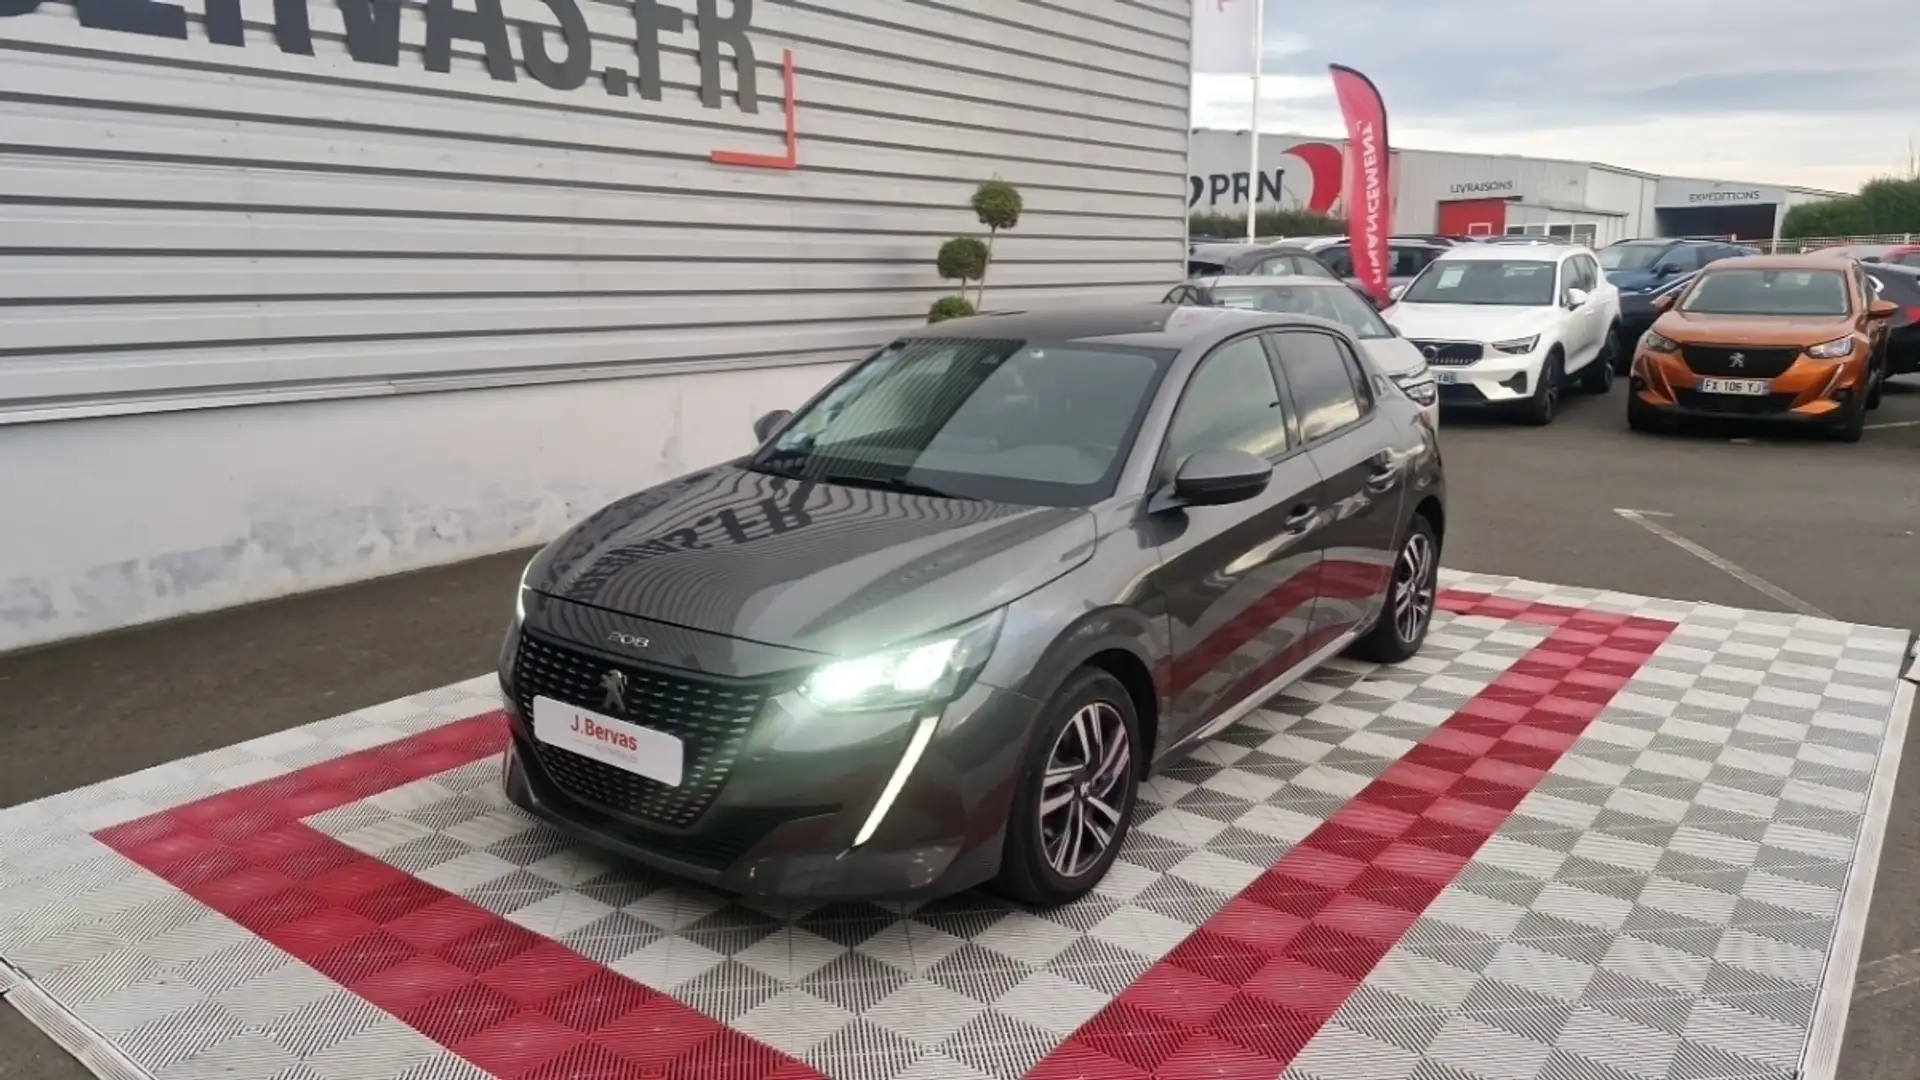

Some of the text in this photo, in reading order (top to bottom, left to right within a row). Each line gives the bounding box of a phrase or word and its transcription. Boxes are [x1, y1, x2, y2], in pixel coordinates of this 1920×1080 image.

[1209, 169, 1285, 205] PRN
[1450, 181, 1513, 193] LIVRAISONS
[607, 631, 650, 648] 208
[570, 714, 638, 752] J.Bervas
